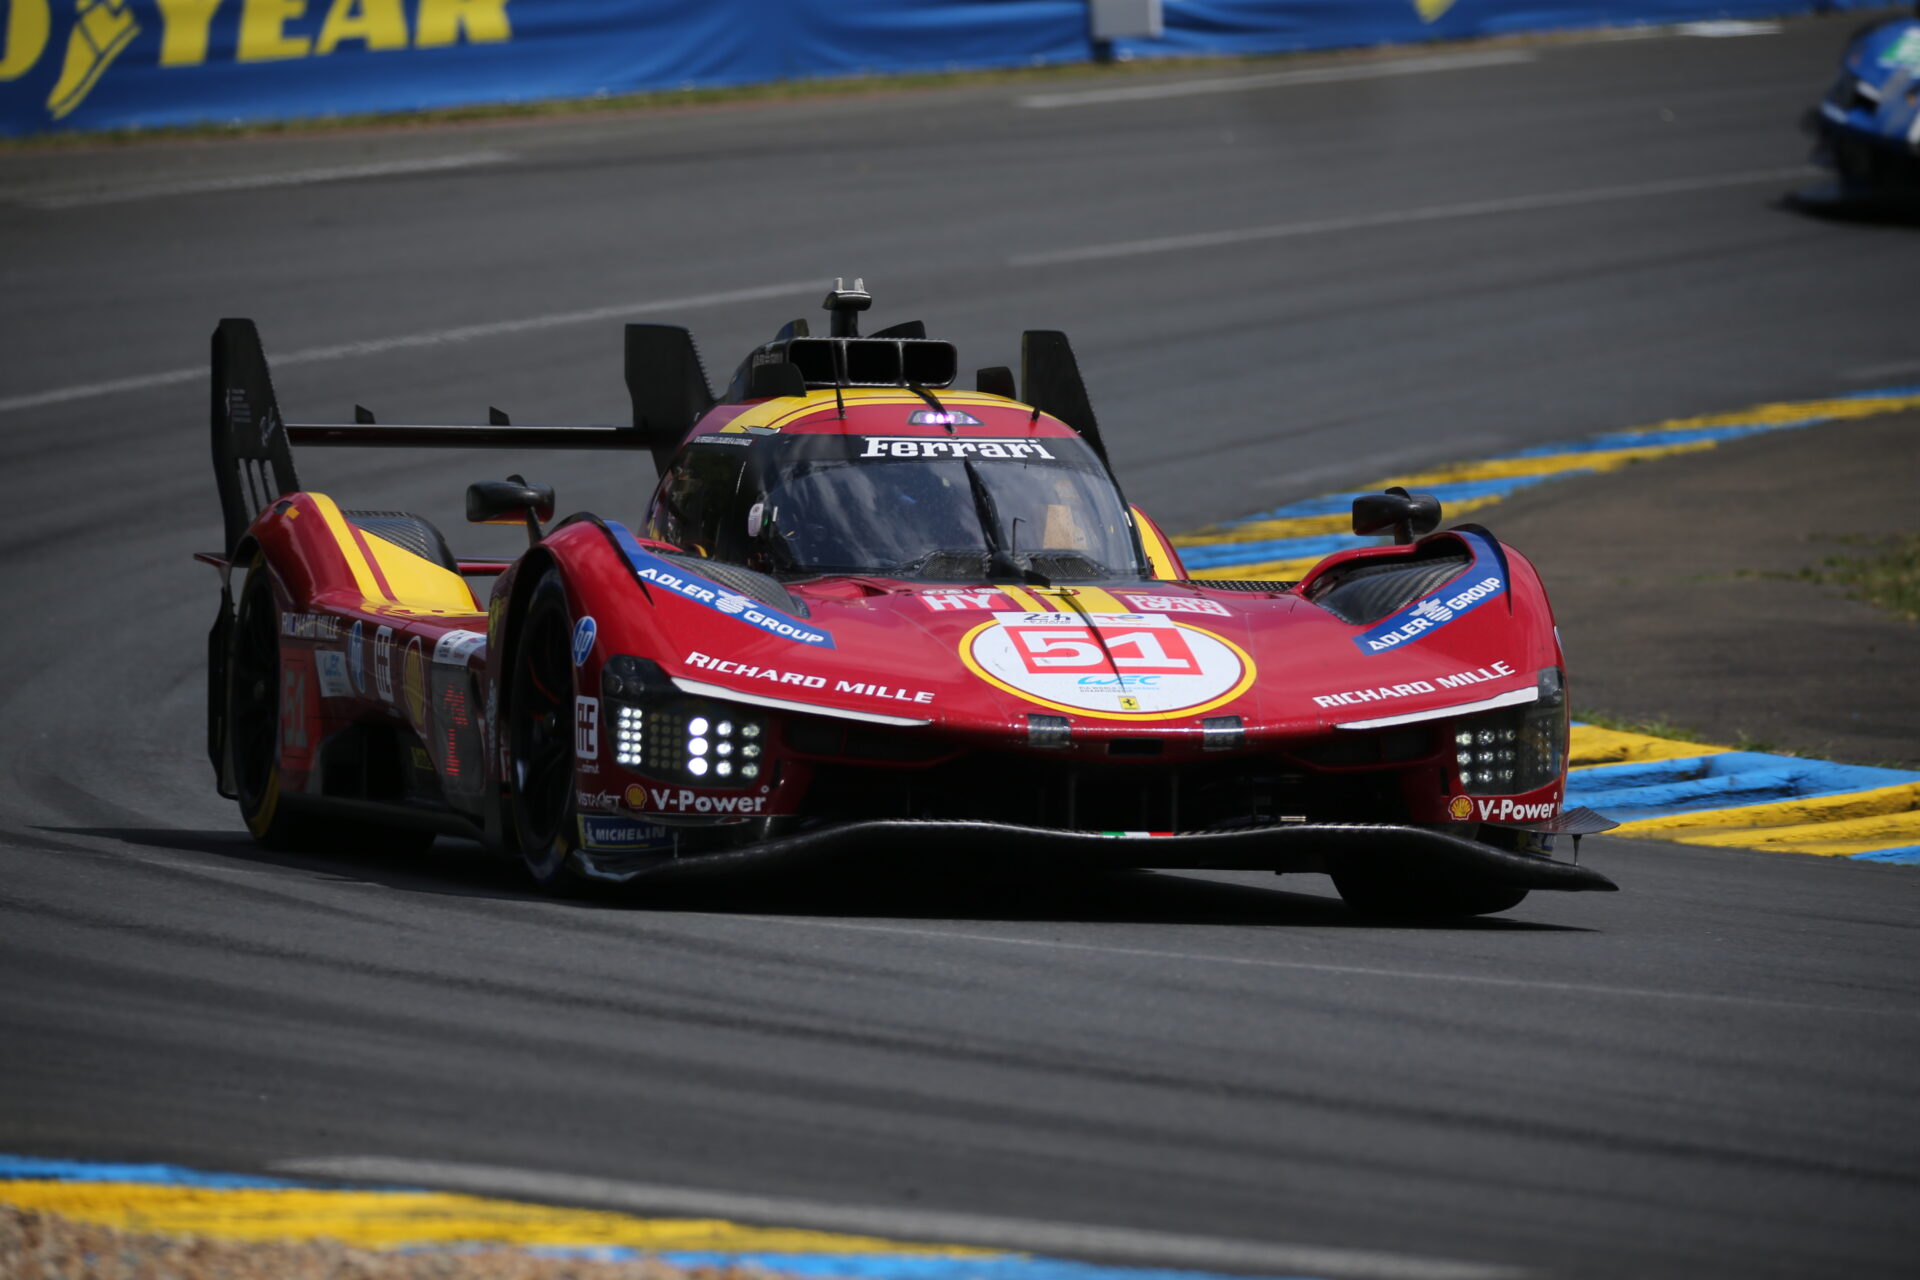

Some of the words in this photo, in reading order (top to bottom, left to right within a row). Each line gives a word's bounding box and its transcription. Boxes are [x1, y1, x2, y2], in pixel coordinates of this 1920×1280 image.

[860, 437, 1056, 460] Ferrari
[636, 567, 715, 603] ADLER
[743, 609, 826, 644] GROUP
[921, 594, 993, 611] HY
[1367, 617, 1434, 651] ADLER
[1446, 577, 1502, 611] GROUP
[1017, 630, 1191, 668] 51
[684, 651, 827, 689] RICHARD
[835, 680, 936, 704] MILLE
[1077, 675, 1162, 686] WEC
[1312, 680, 1436, 709] RICHARD
[1437, 660, 1517, 690] MILLE
[651, 789, 766, 812] V-Power
[1477, 799, 1556, 821] V-Power
[596, 826, 667, 841] MICHELIN
